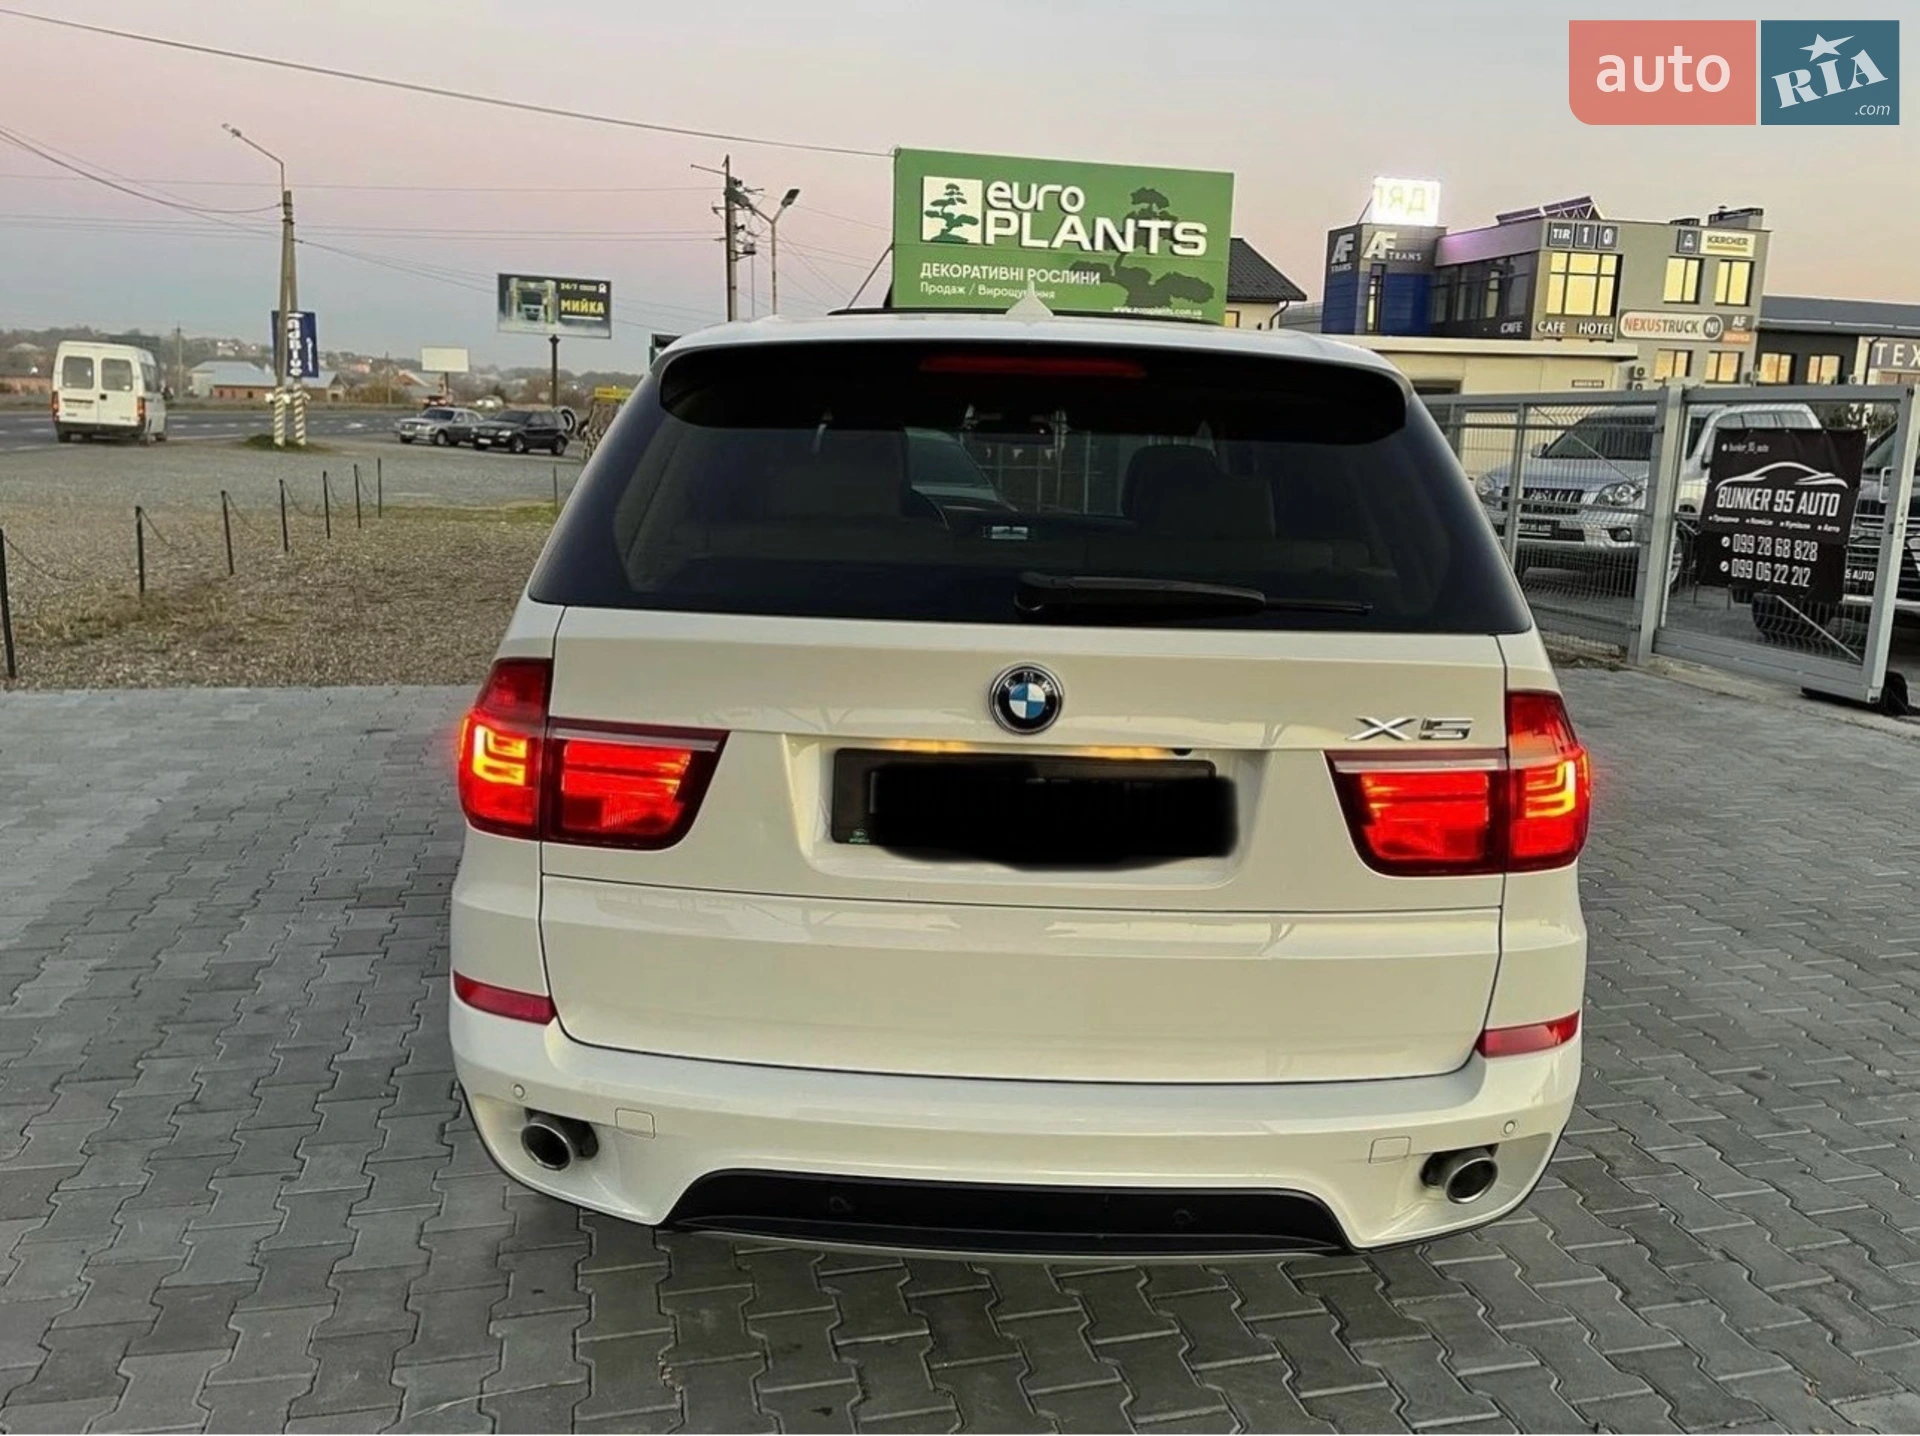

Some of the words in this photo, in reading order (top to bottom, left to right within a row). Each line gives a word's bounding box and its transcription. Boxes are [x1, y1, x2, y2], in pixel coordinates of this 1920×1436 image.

[986, 181, 1085, 213] euro
[984, 210, 1208, 256] PLANTS
[1552, 227, 1571, 240] TIR
[1388, 251, 1422, 261] TRANS
[920, 262, 1024, 281] ДЕКОРАТИВНІ
[1027, 268, 1101, 286] РОСЛИНИ
[920, 281, 966, 295] Продаж
[560, 298, 605, 314] МИЙКА
[1537, 321, 1566, 333] CAFE
[1578, 322, 1614, 335] HOTEL
[1624, 317, 1699, 334] NEXUSTRUCK
[1732, 315, 1747, 327] AF
[1874, 343, 1920, 367] TEX
[1716, 486, 1771, 511] BUNKER
[1773, 489, 1796, 513] 95
[1796, 491, 1841, 517] AUTO
[1733, 533, 1755, 553] 099
[1757, 535, 1772, 556] 28
[1775, 537, 1791, 558] 68
[1794, 540, 1818, 561] 828
[1731, 558, 1753, 579] 099
[1755, 561, 1771, 581] 06
[1773, 563, 1789, 585] 22
[1790, 565, 1811, 587] 212
[1853, 570, 1875, 581] AUTO
[1345, 716, 1475, 742] X5
